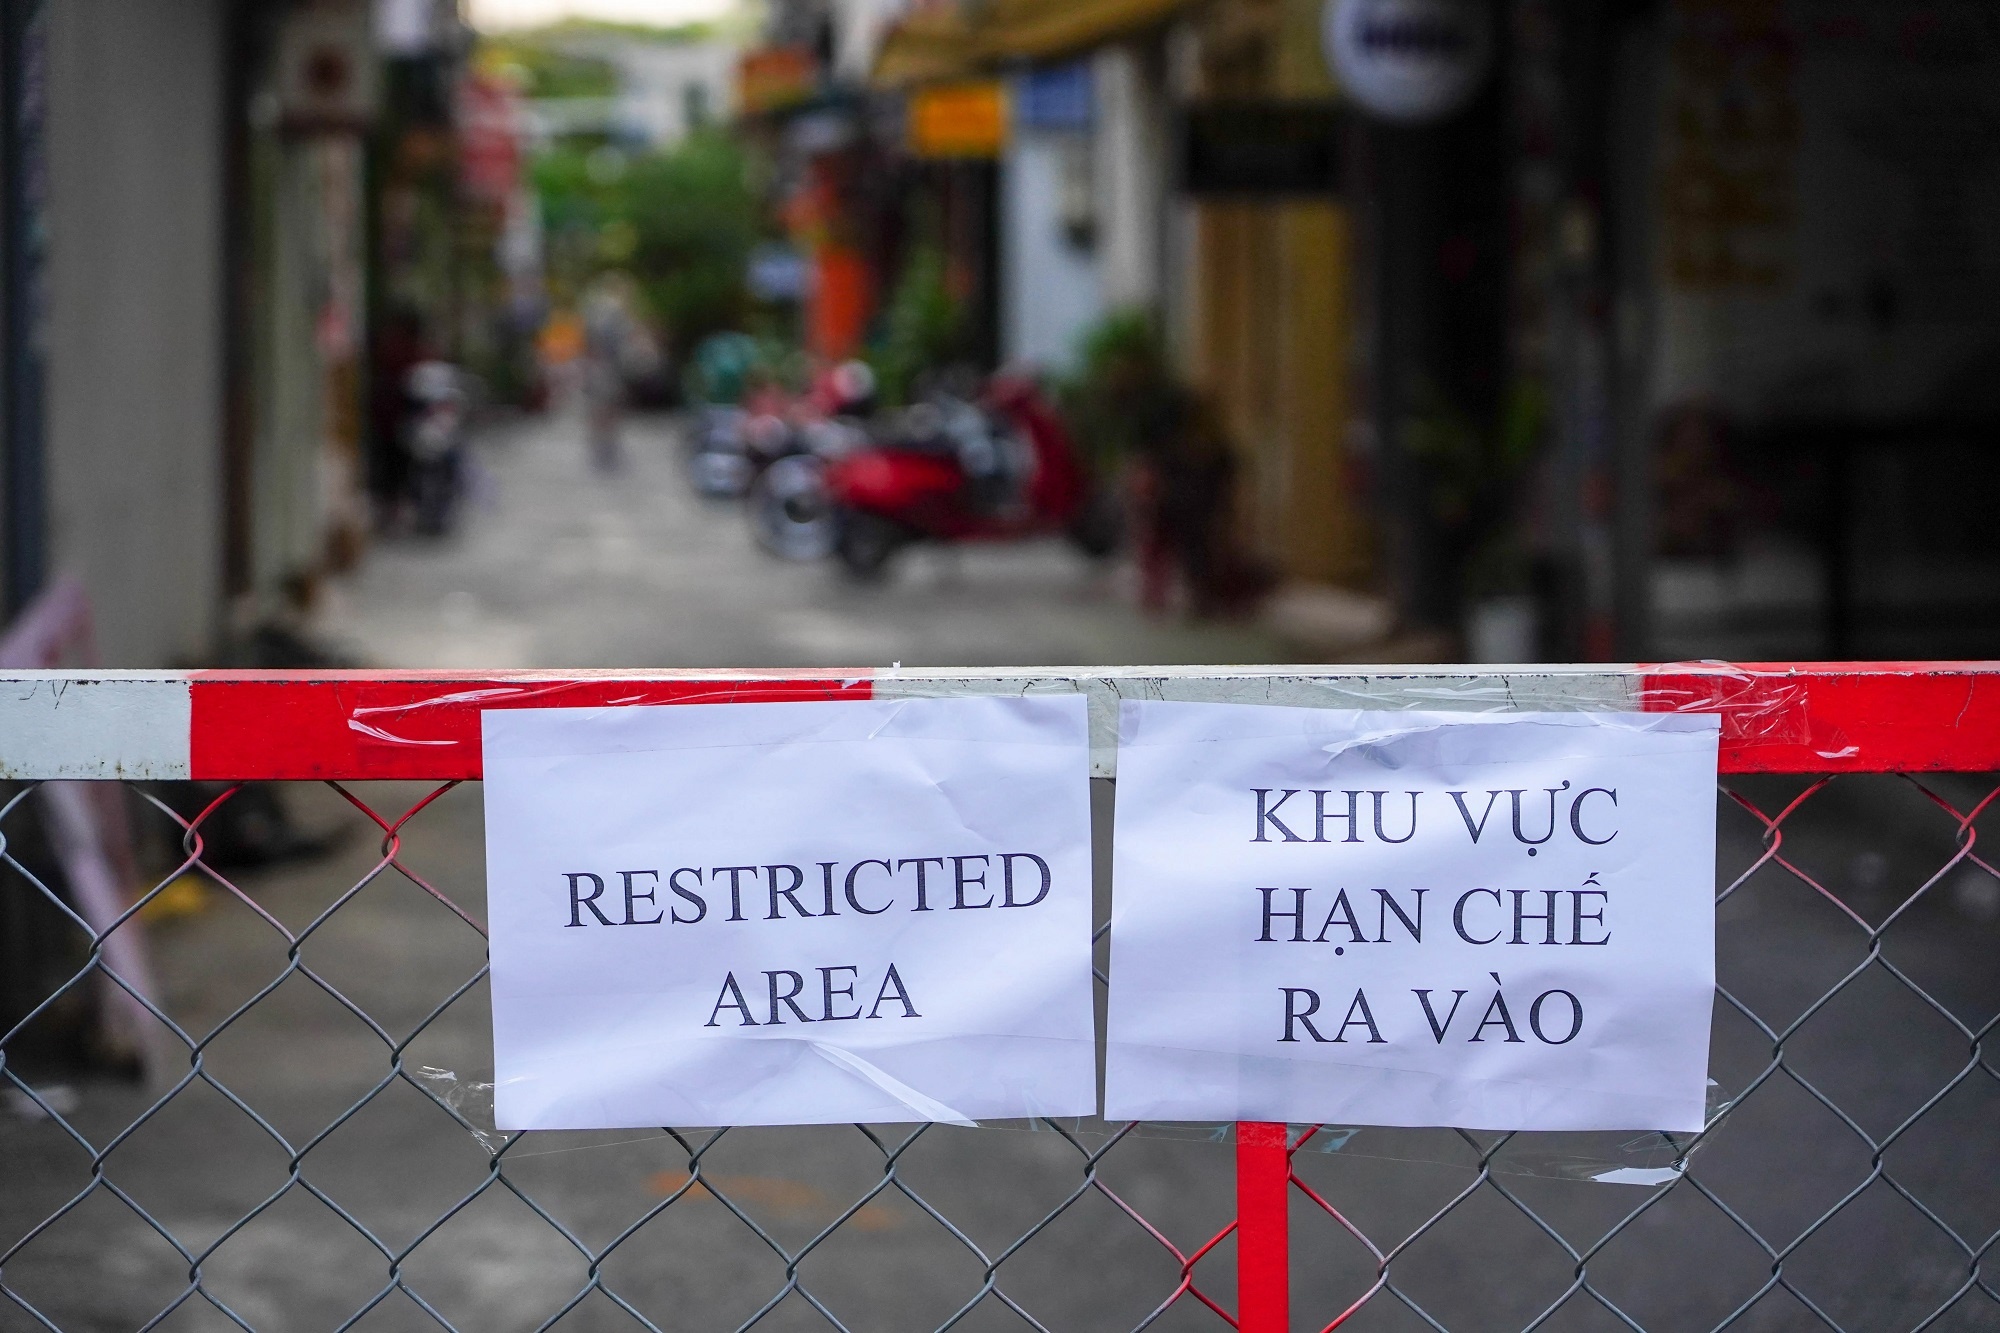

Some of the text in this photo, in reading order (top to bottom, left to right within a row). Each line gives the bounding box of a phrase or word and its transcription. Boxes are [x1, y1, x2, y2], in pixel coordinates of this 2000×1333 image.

[1249, 779, 1619, 857] KHU VỰC
[561, 852, 1050, 927] RESTRICTED
[1253, 872, 1612, 956] HẠN CHẾ
[703, 962, 921, 1026] AREA
[1276, 971, 1584, 1045] RA VÀO
